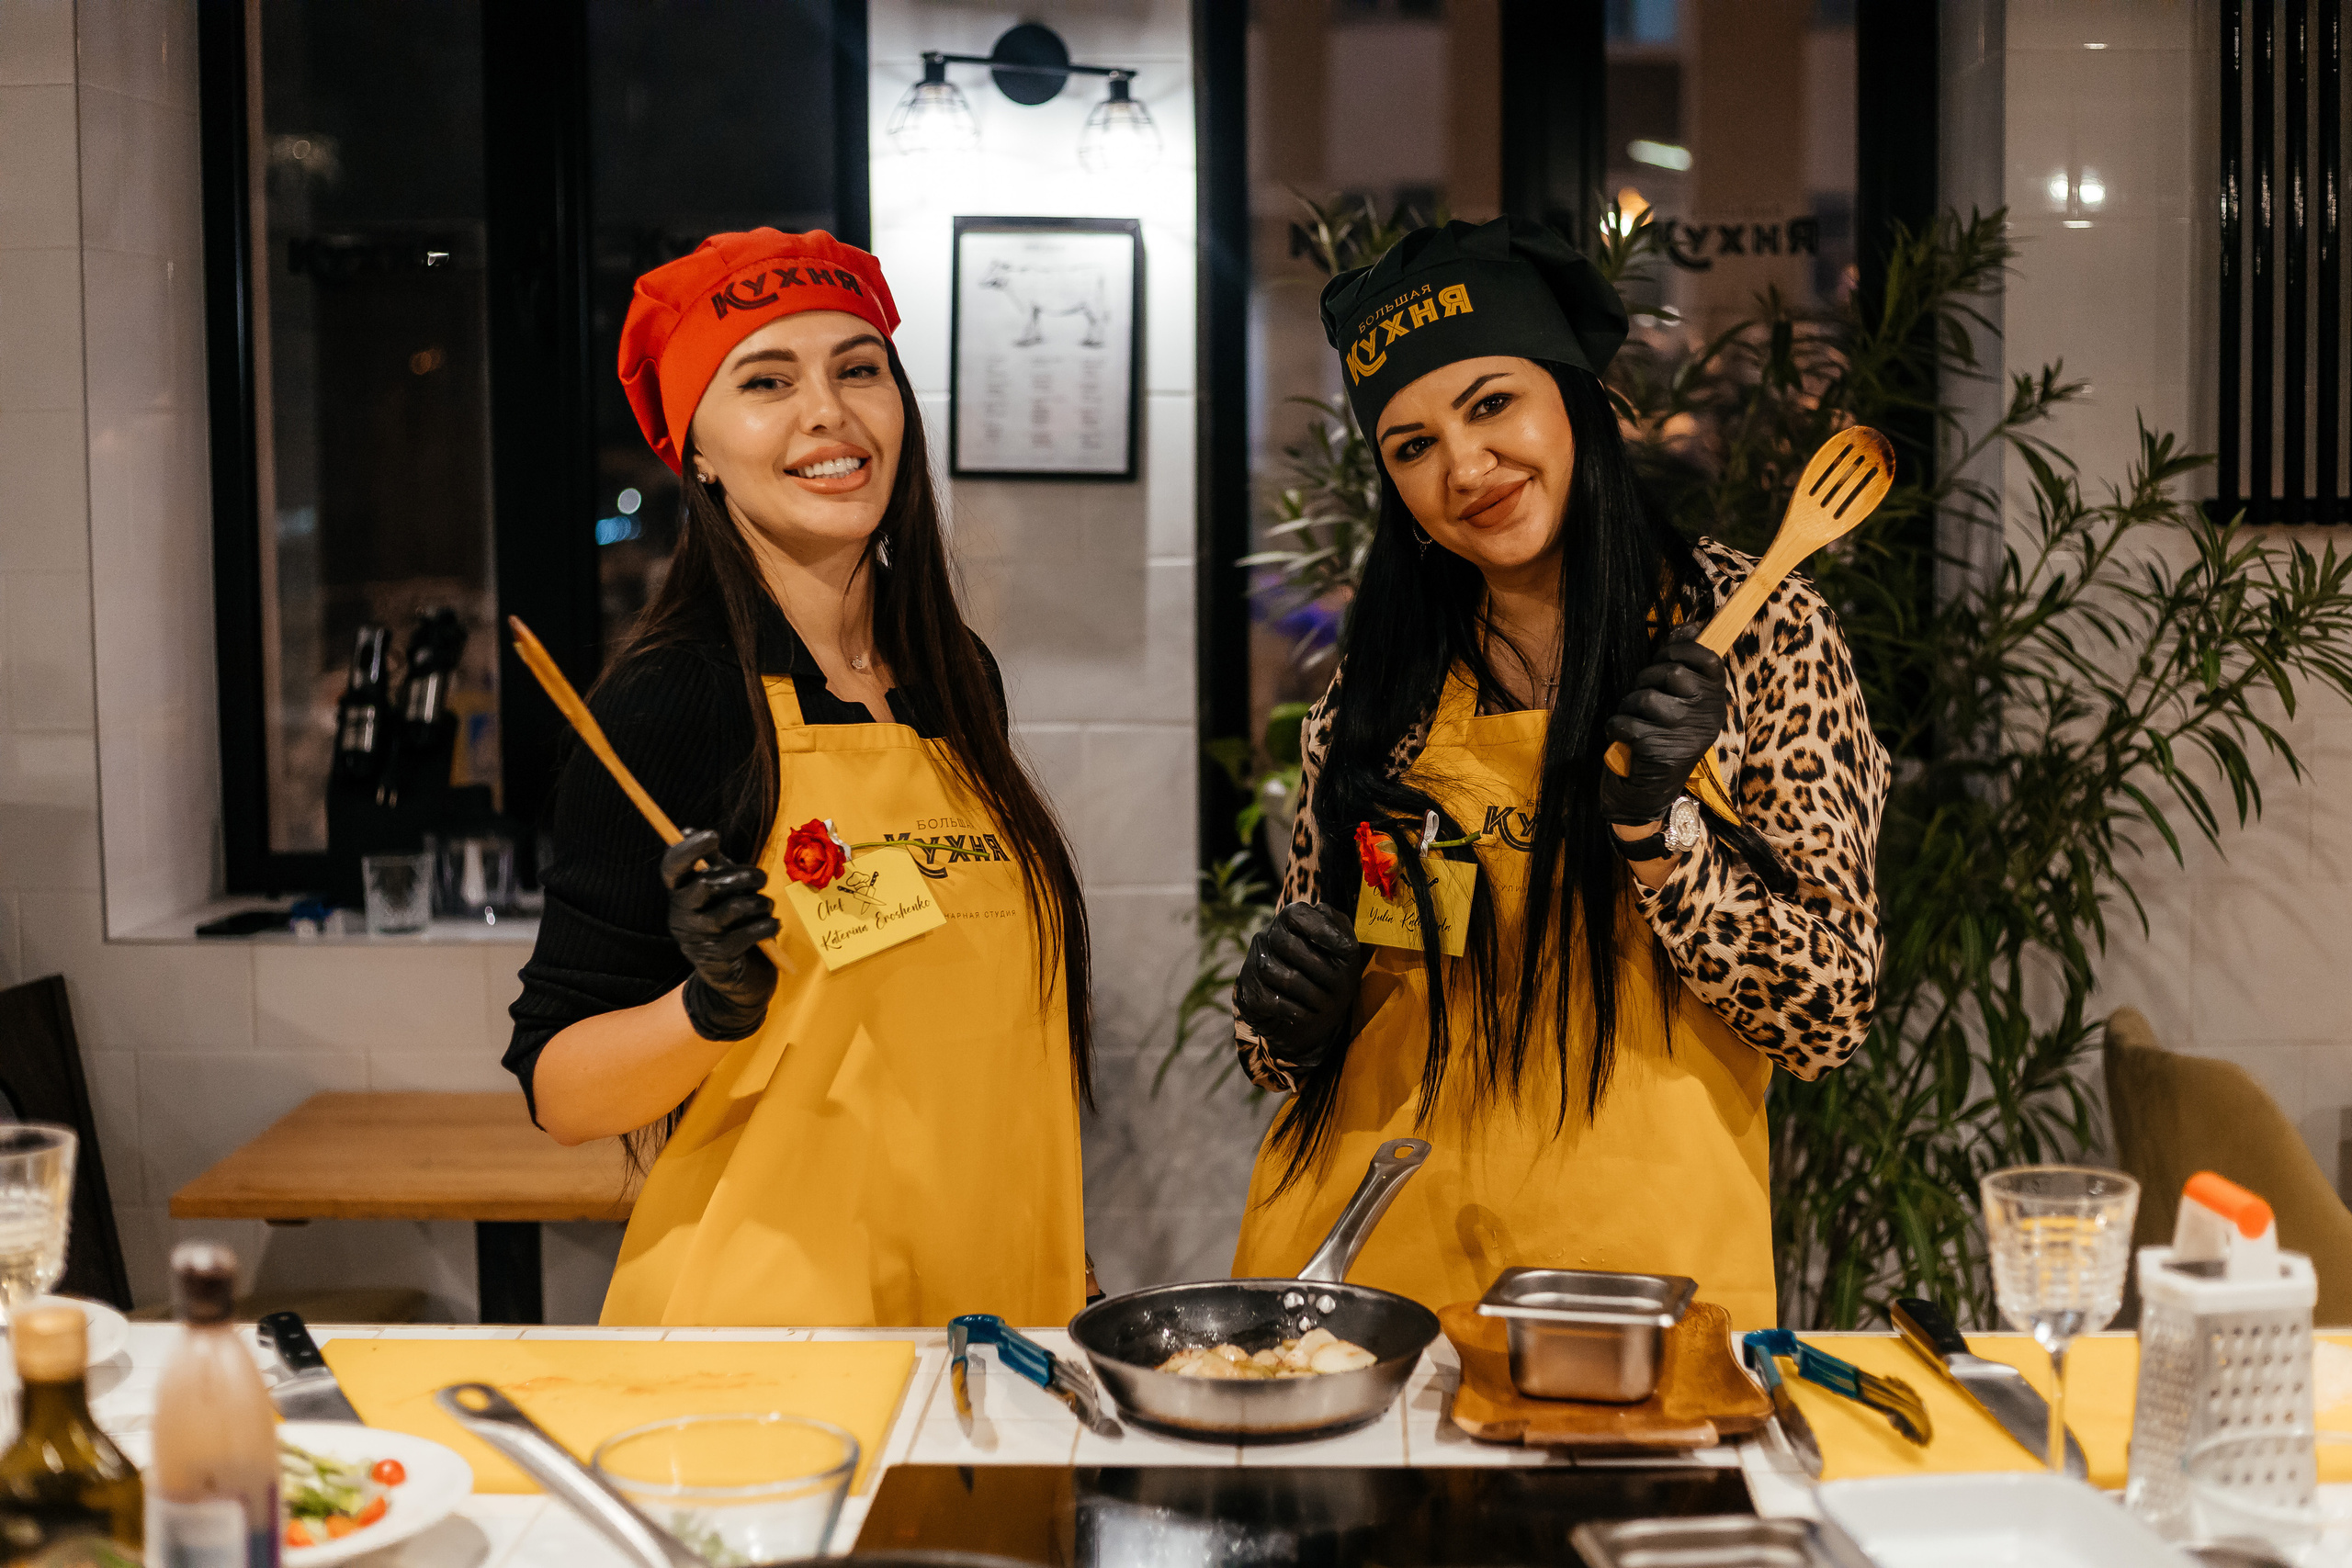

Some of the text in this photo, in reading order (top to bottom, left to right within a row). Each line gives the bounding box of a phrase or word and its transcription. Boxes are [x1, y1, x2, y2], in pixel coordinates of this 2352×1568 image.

[710, 266, 865, 321] КУХНЯ
[1358, 284, 1432, 333] БОЛЬШАЯ
[1346, 283, 1474, 387] КУХНЯ
[916, 818, 975, 830] БОЛЬША
[818, 897, 844, 921] Chef
[944, 909, 1016, 919] НАРНАЯ СТУДИЯ
[1369, 907, 1394, 926] Yulia
[820, 924, 868, 952] Katerina
